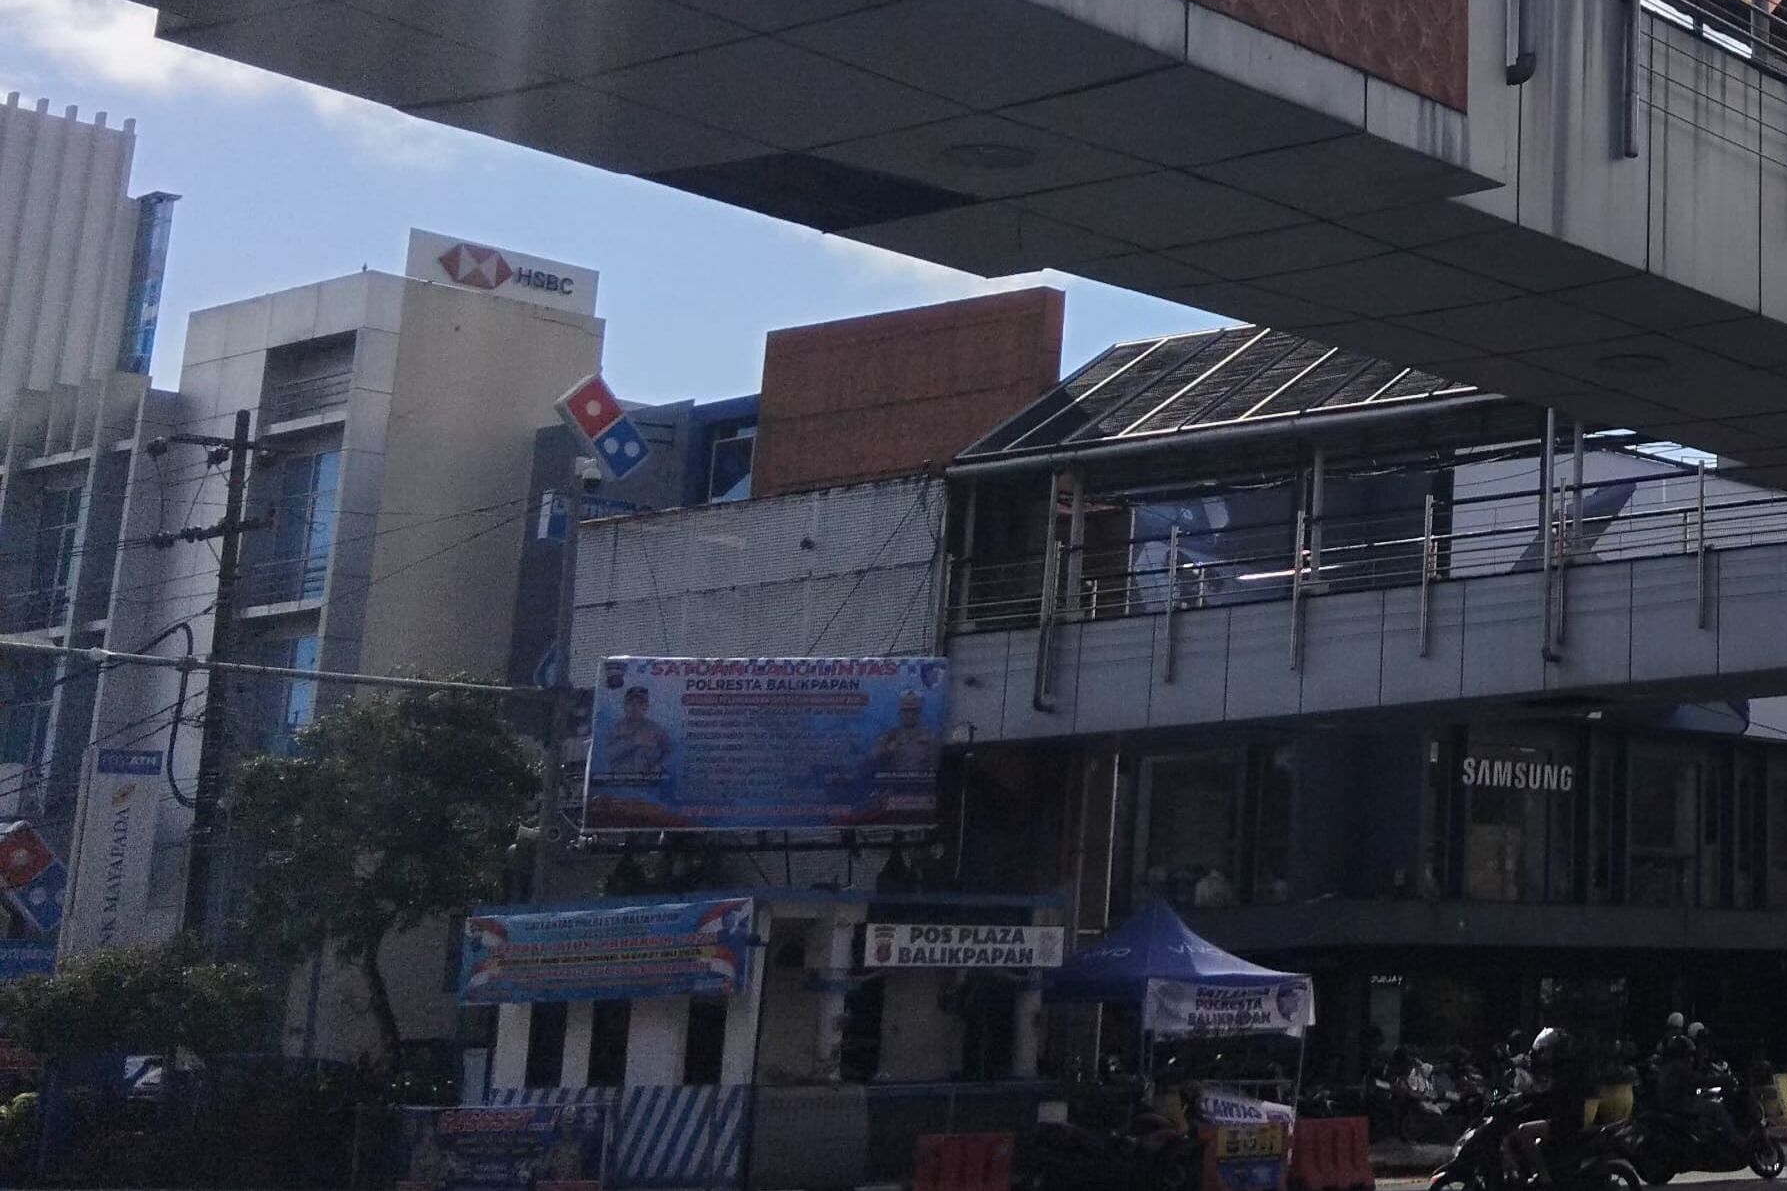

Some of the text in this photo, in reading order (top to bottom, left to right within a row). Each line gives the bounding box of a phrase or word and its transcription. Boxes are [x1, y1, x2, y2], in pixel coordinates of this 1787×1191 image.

[517, 267, 574, 295] HSBC
[686, 678, 860, 691] POLRESTA BALIKPAPAN
[1462, 757, 1573, 792] SAMSUNG
[102, 806, 130, 913] MAYAPADA
[910, 927, 1025, 945] POS PLAZA
[898, 946, 1033, 964] BALIKPAPAN
